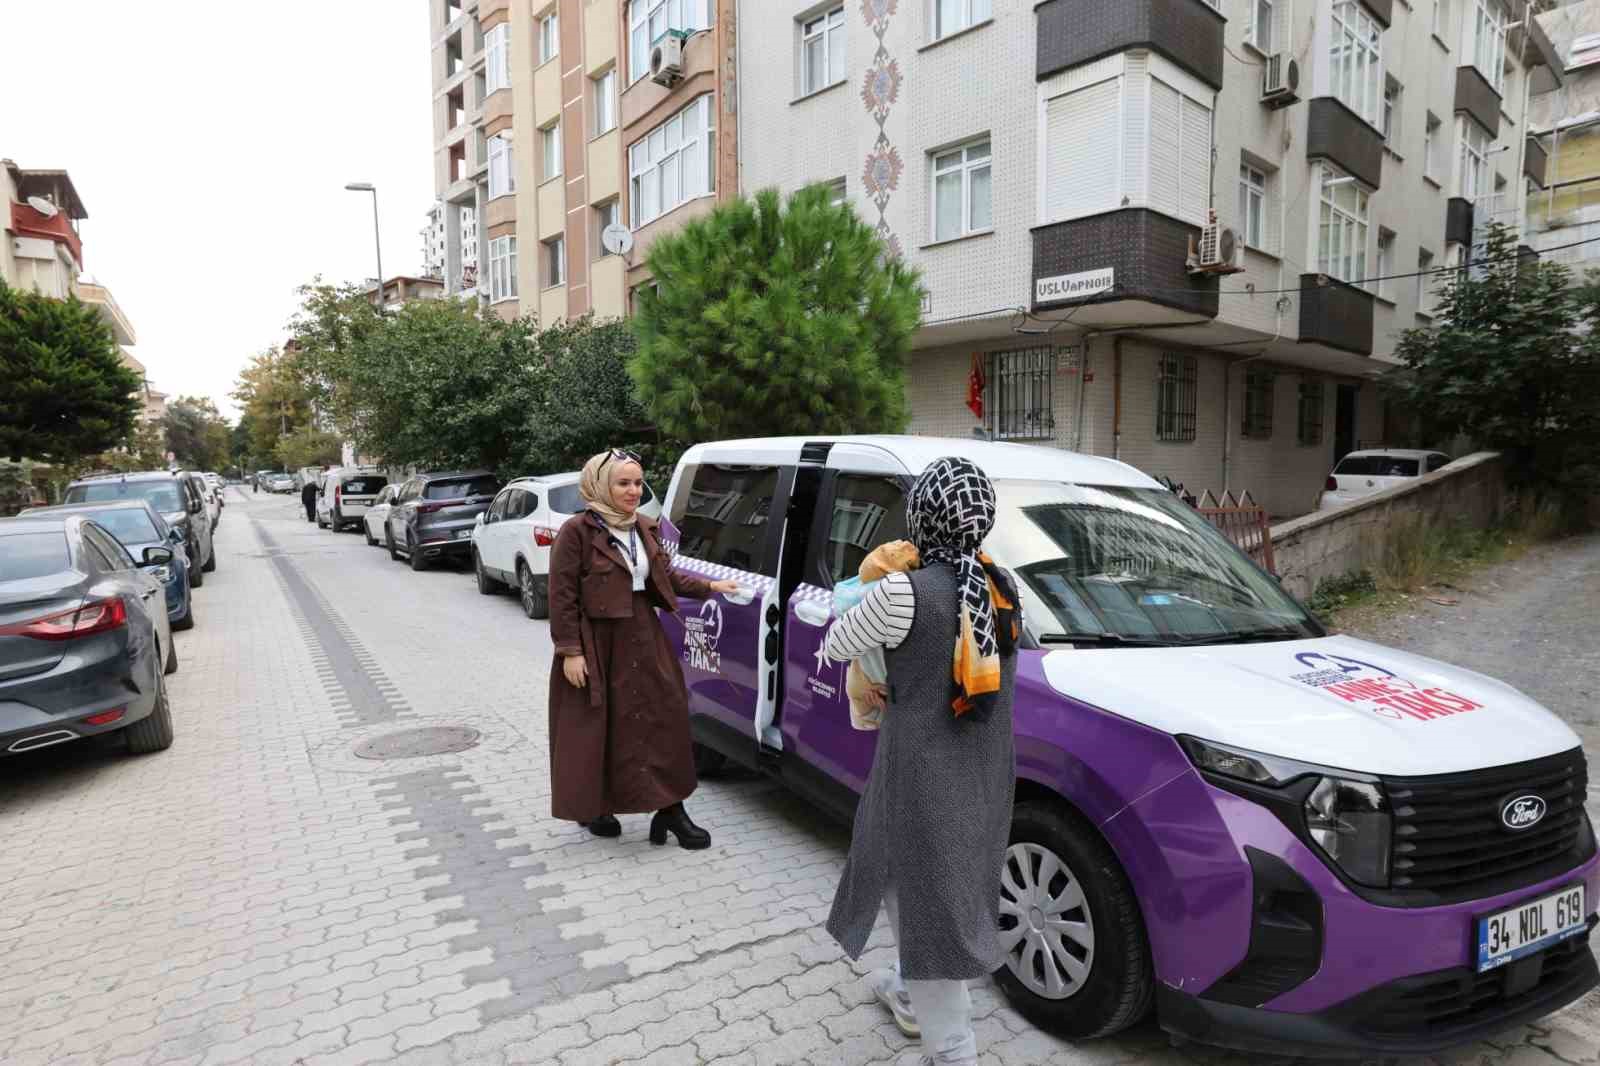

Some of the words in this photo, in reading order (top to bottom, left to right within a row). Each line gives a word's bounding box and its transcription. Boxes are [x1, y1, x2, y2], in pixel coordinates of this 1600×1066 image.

[1323, 677, 1404, 702] ANNE
[1511, 800, 1539, 824] Ford
[1489, 915, 1510, 954] 34
[1519, 903, 1548, 944] NDL
[1556, 891, 1581, 929] 619
